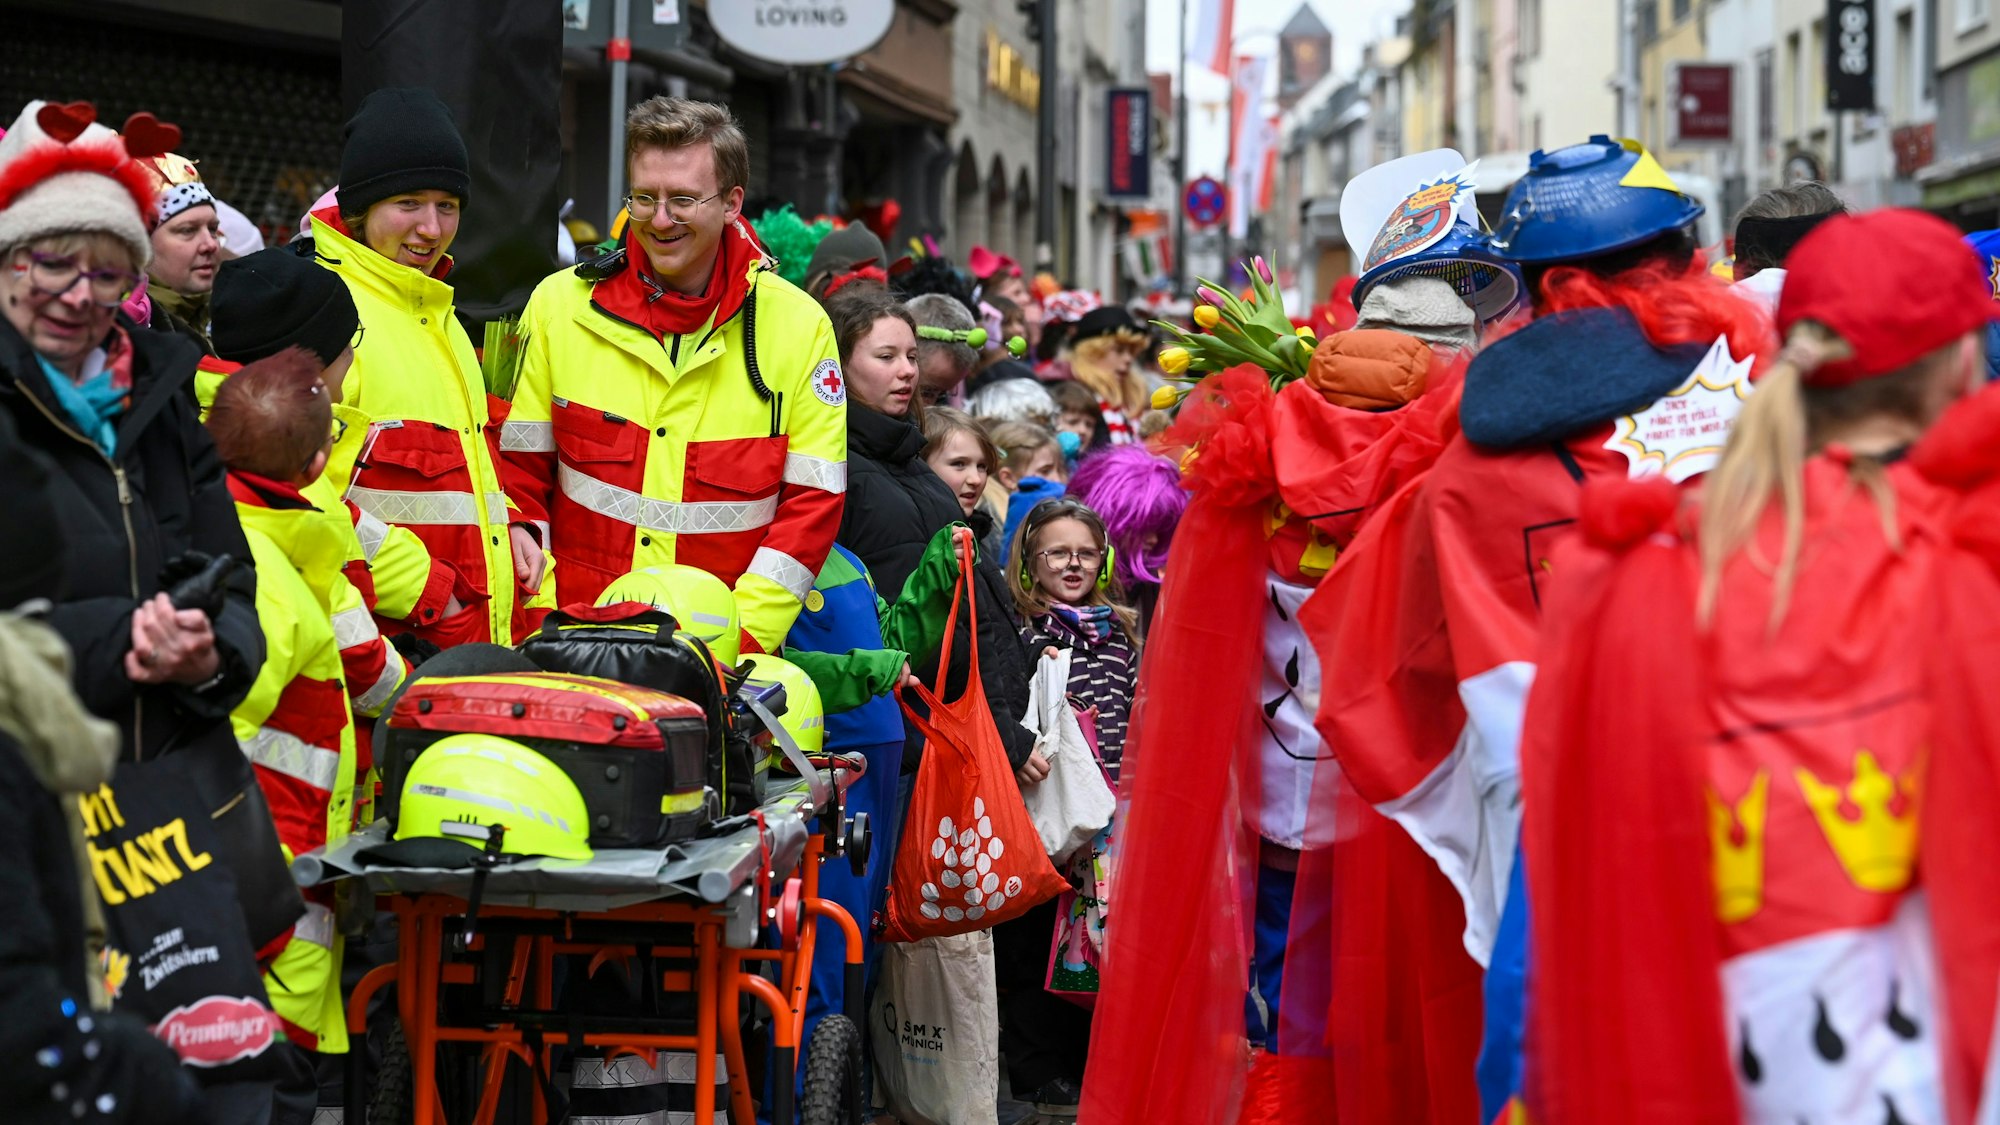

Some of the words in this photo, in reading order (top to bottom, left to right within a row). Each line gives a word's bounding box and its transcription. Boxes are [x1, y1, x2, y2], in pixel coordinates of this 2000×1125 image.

[756, 7, 847, 27] LOVING
[815, 383, 835, 402] ROTES
[168, 1015, 266, 1047] Penninger
[902, 1034, 943, 1052] MUNICH
